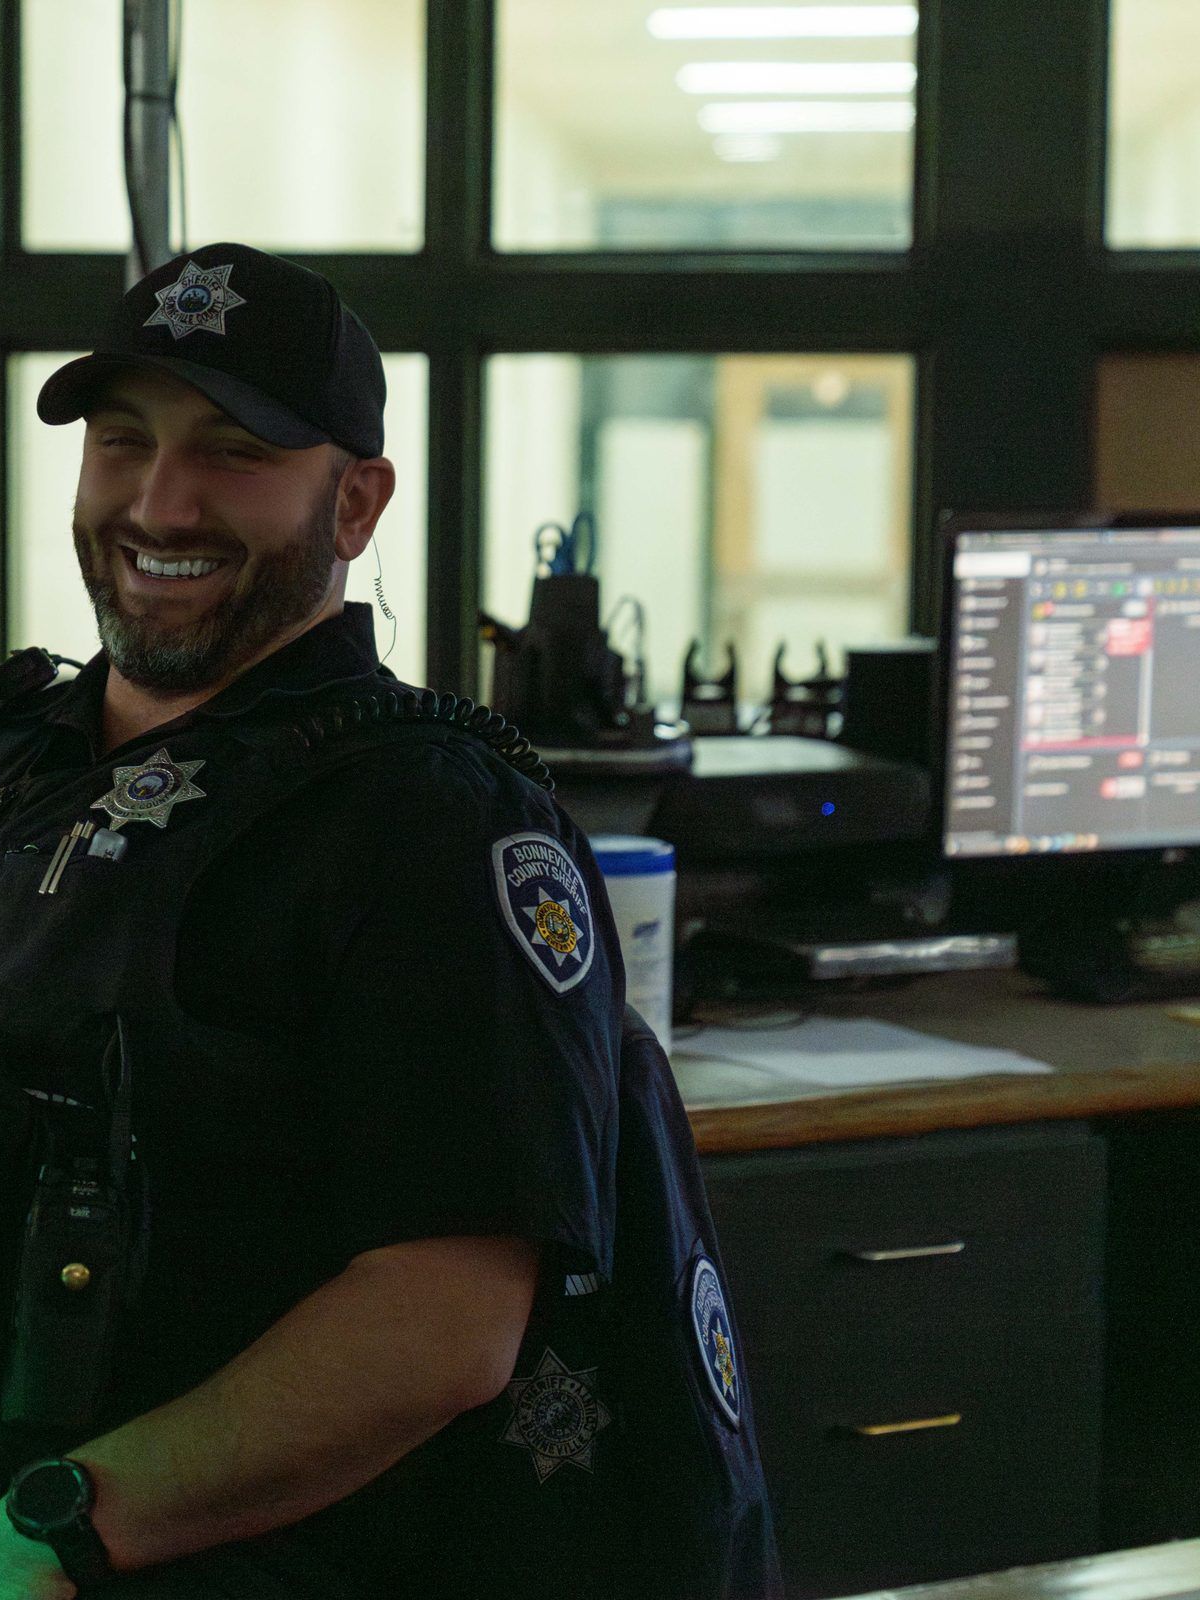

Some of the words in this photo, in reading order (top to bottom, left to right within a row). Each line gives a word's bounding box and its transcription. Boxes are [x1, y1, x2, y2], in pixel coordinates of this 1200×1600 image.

[507, 862, 550, 887] COUNTY
[551, 866, 588, 914] SHERIFF
[512, 844, 578, 887] BONNEVILLE
